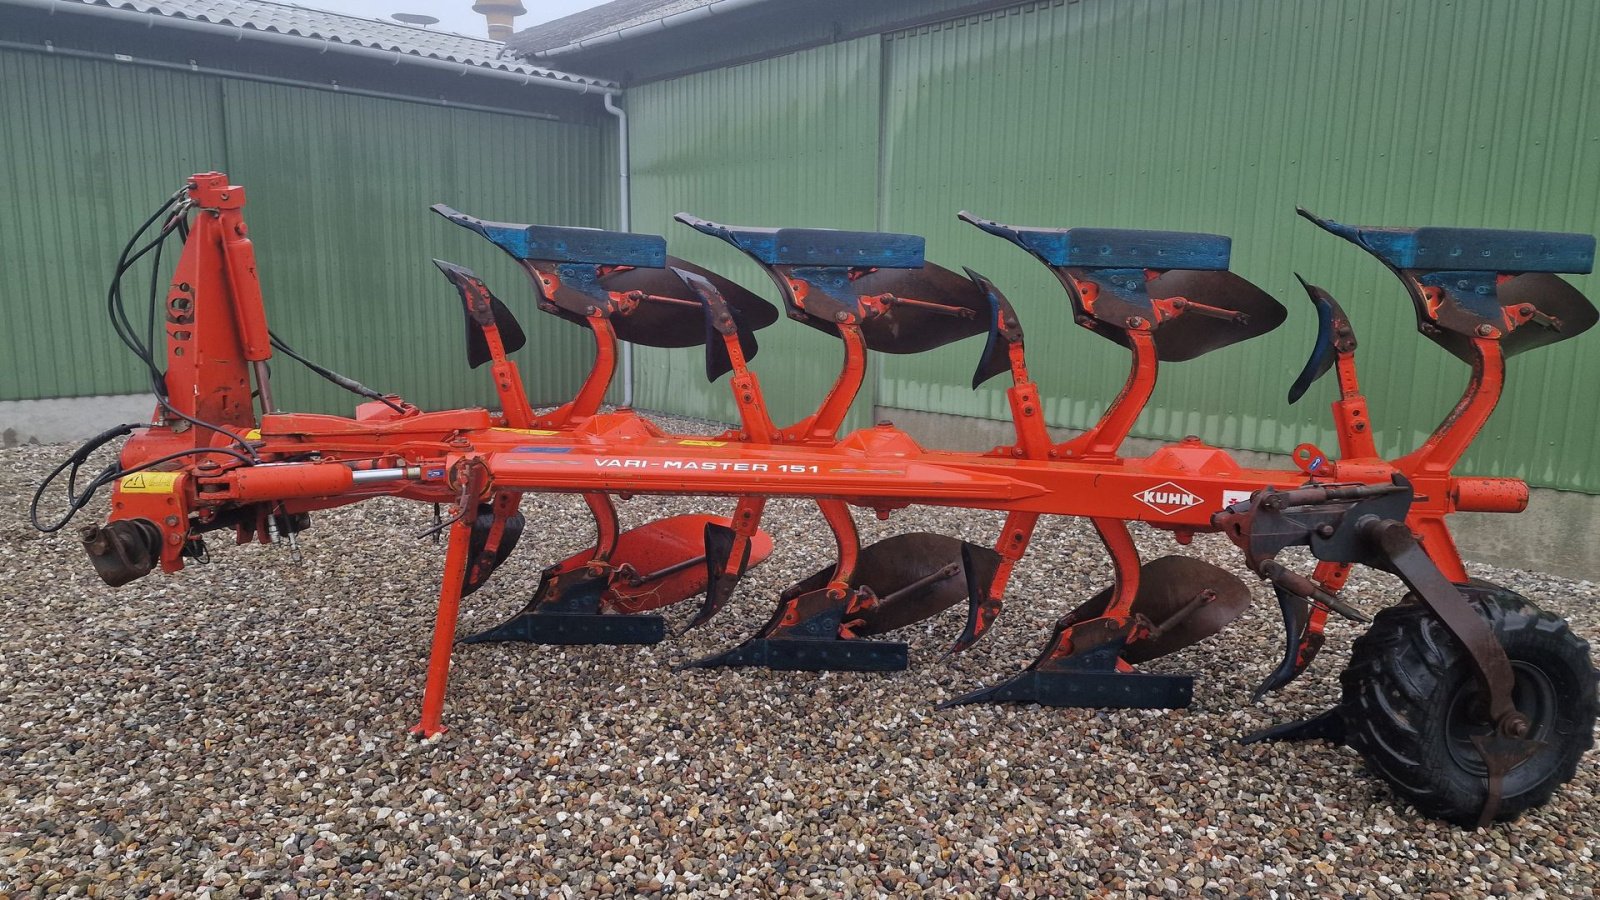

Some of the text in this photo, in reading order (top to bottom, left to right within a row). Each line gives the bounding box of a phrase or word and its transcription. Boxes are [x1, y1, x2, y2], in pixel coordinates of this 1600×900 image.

[595, 458, 818, 473] VARI-MASTER 151
[1143, 491, 1194, 506] KUHN
